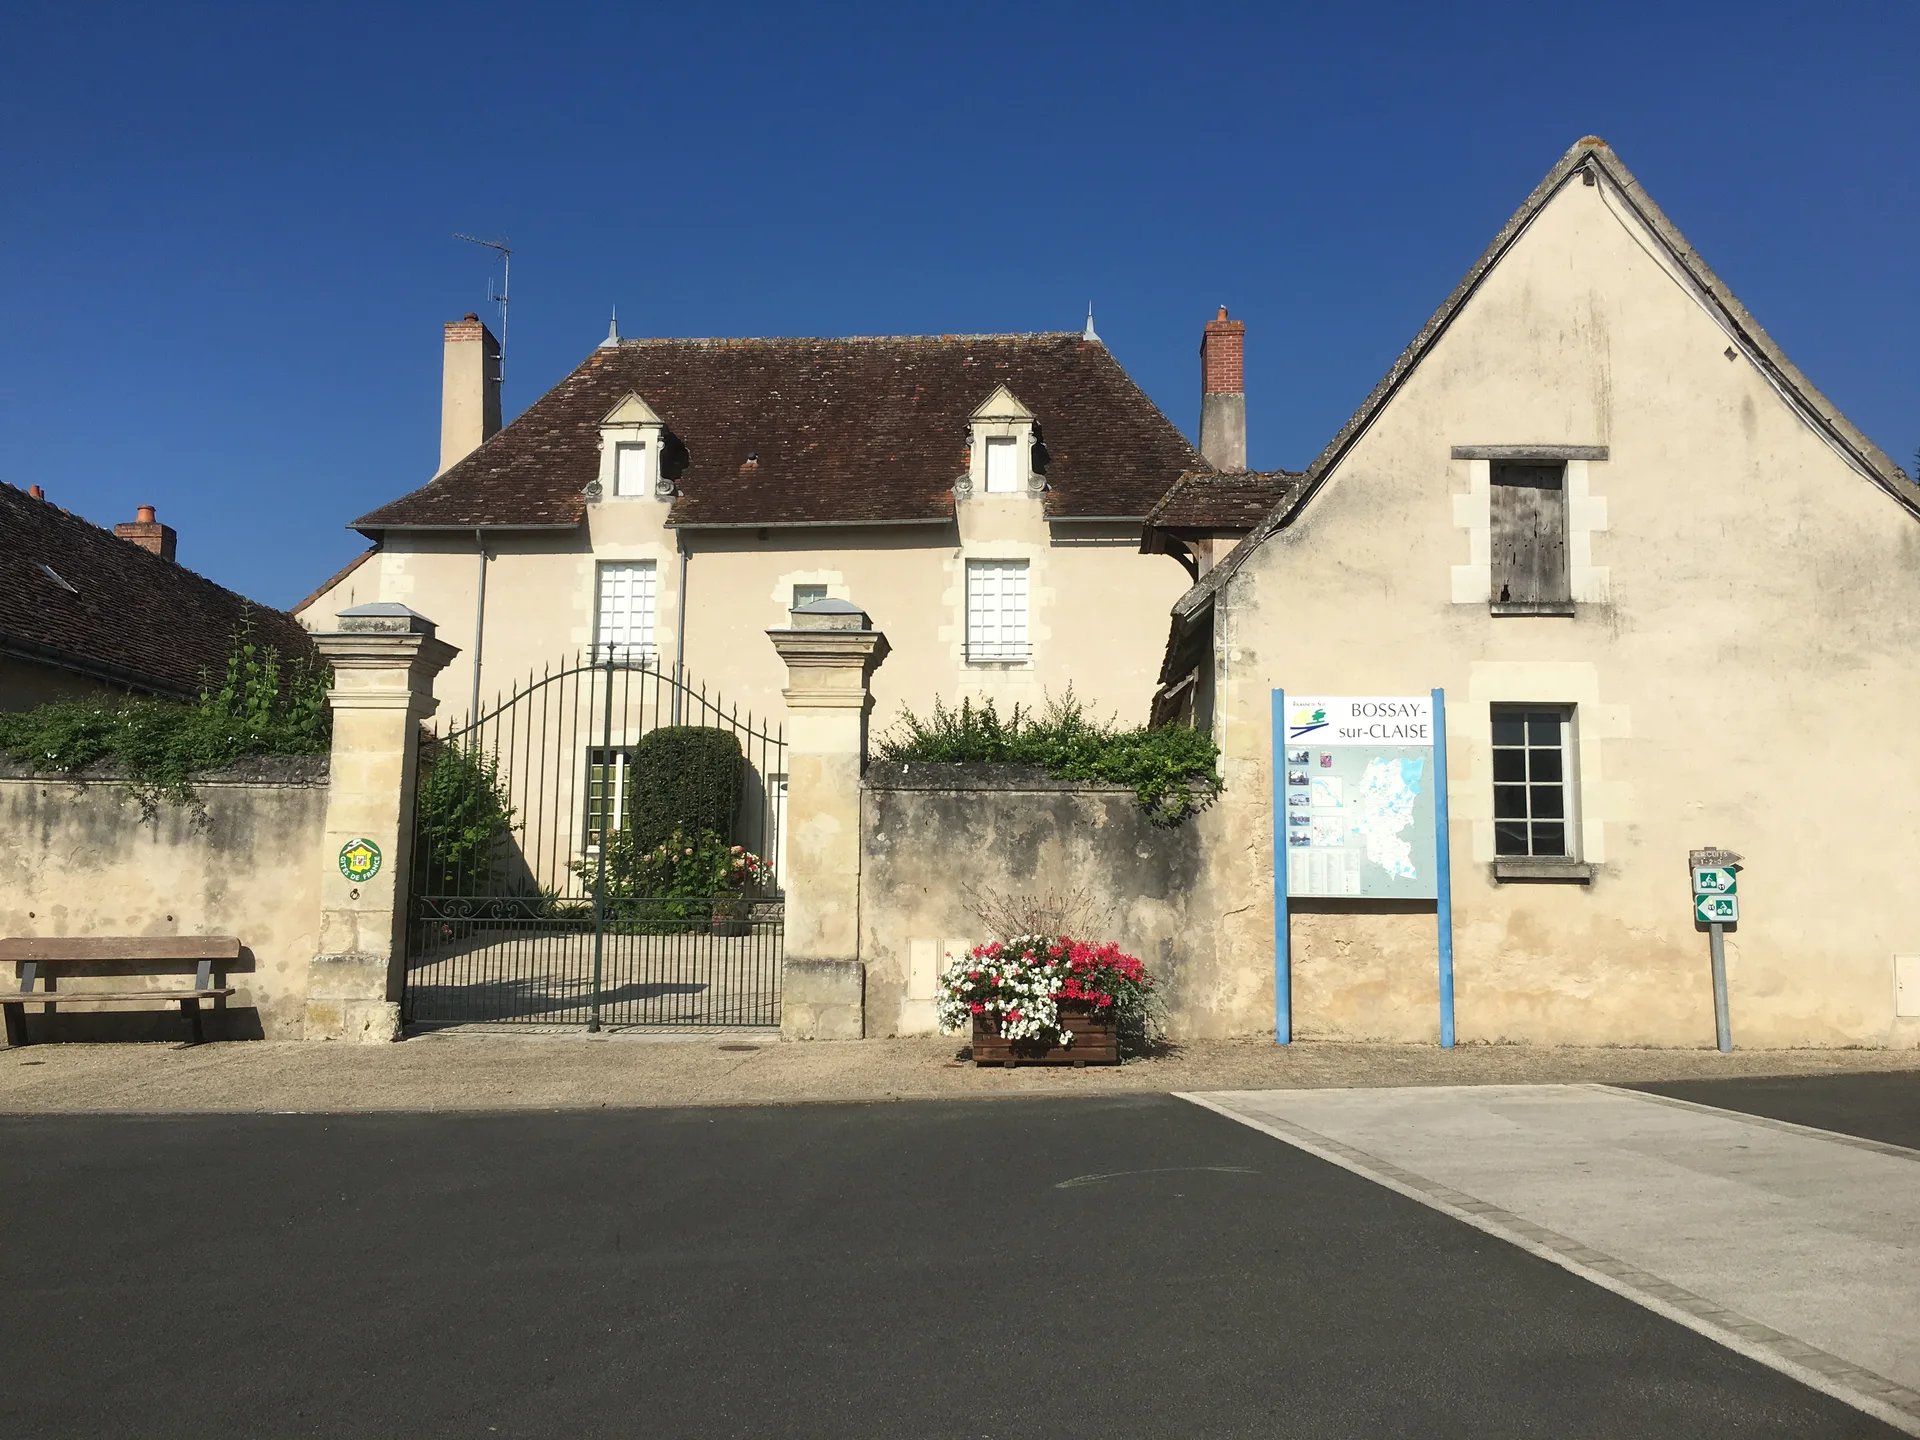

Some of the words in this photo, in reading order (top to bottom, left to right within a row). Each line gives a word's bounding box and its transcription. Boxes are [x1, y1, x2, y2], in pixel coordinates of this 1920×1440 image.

[1351, 702, 1427, 717] BOSSAY-
[1338, 723, 1428, 738] sur-CLAISE
[363, 856, 380, 879] FRANCE
